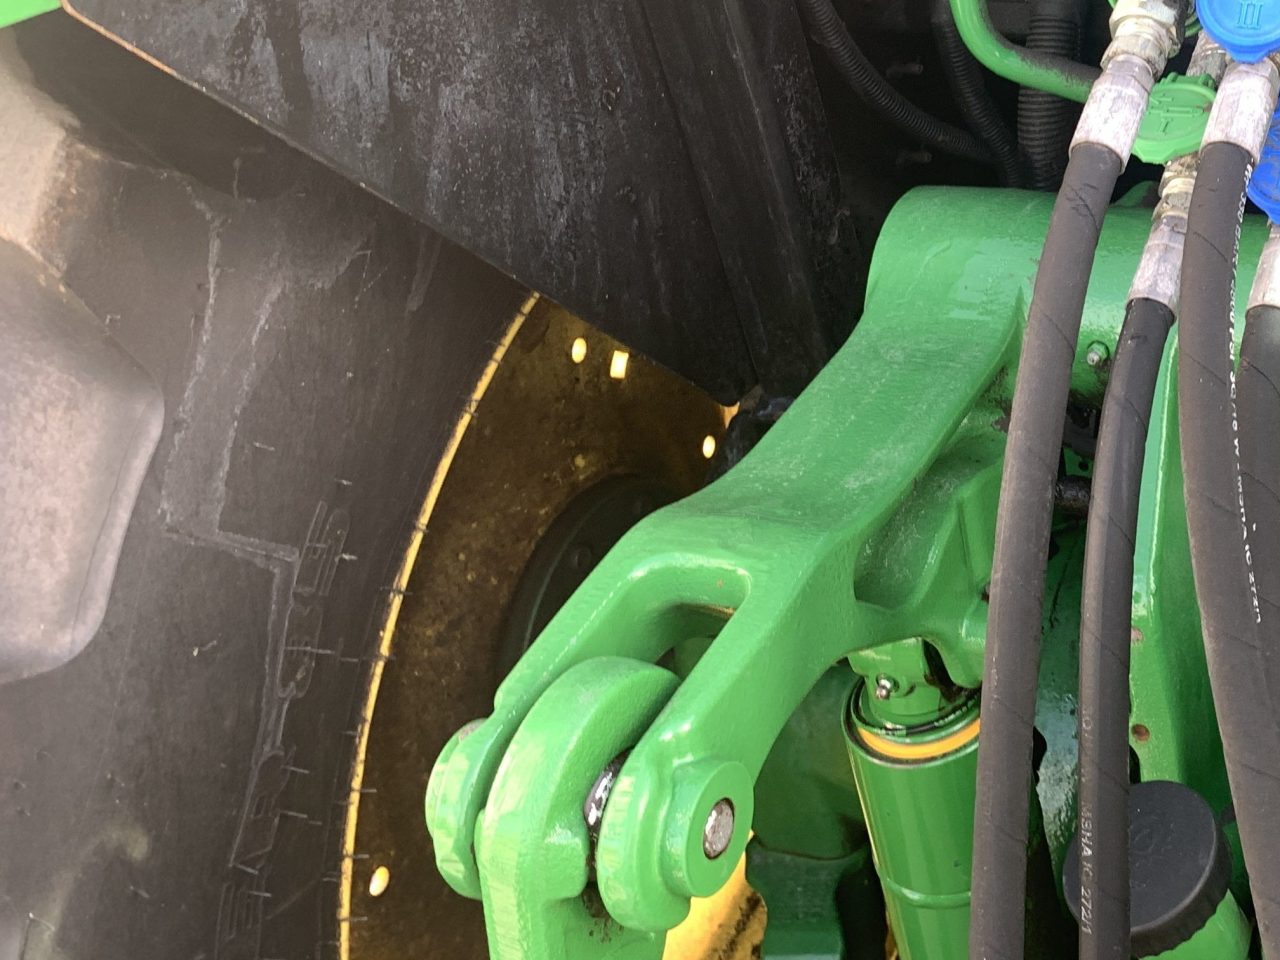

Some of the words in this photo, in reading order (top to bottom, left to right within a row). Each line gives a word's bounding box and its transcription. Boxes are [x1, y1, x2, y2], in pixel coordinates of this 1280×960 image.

[1236, 191, 1247, 222] 330
[1080, 801, 1092, 858] MSHA
[1080, 886, 1092, 936] 272/1
